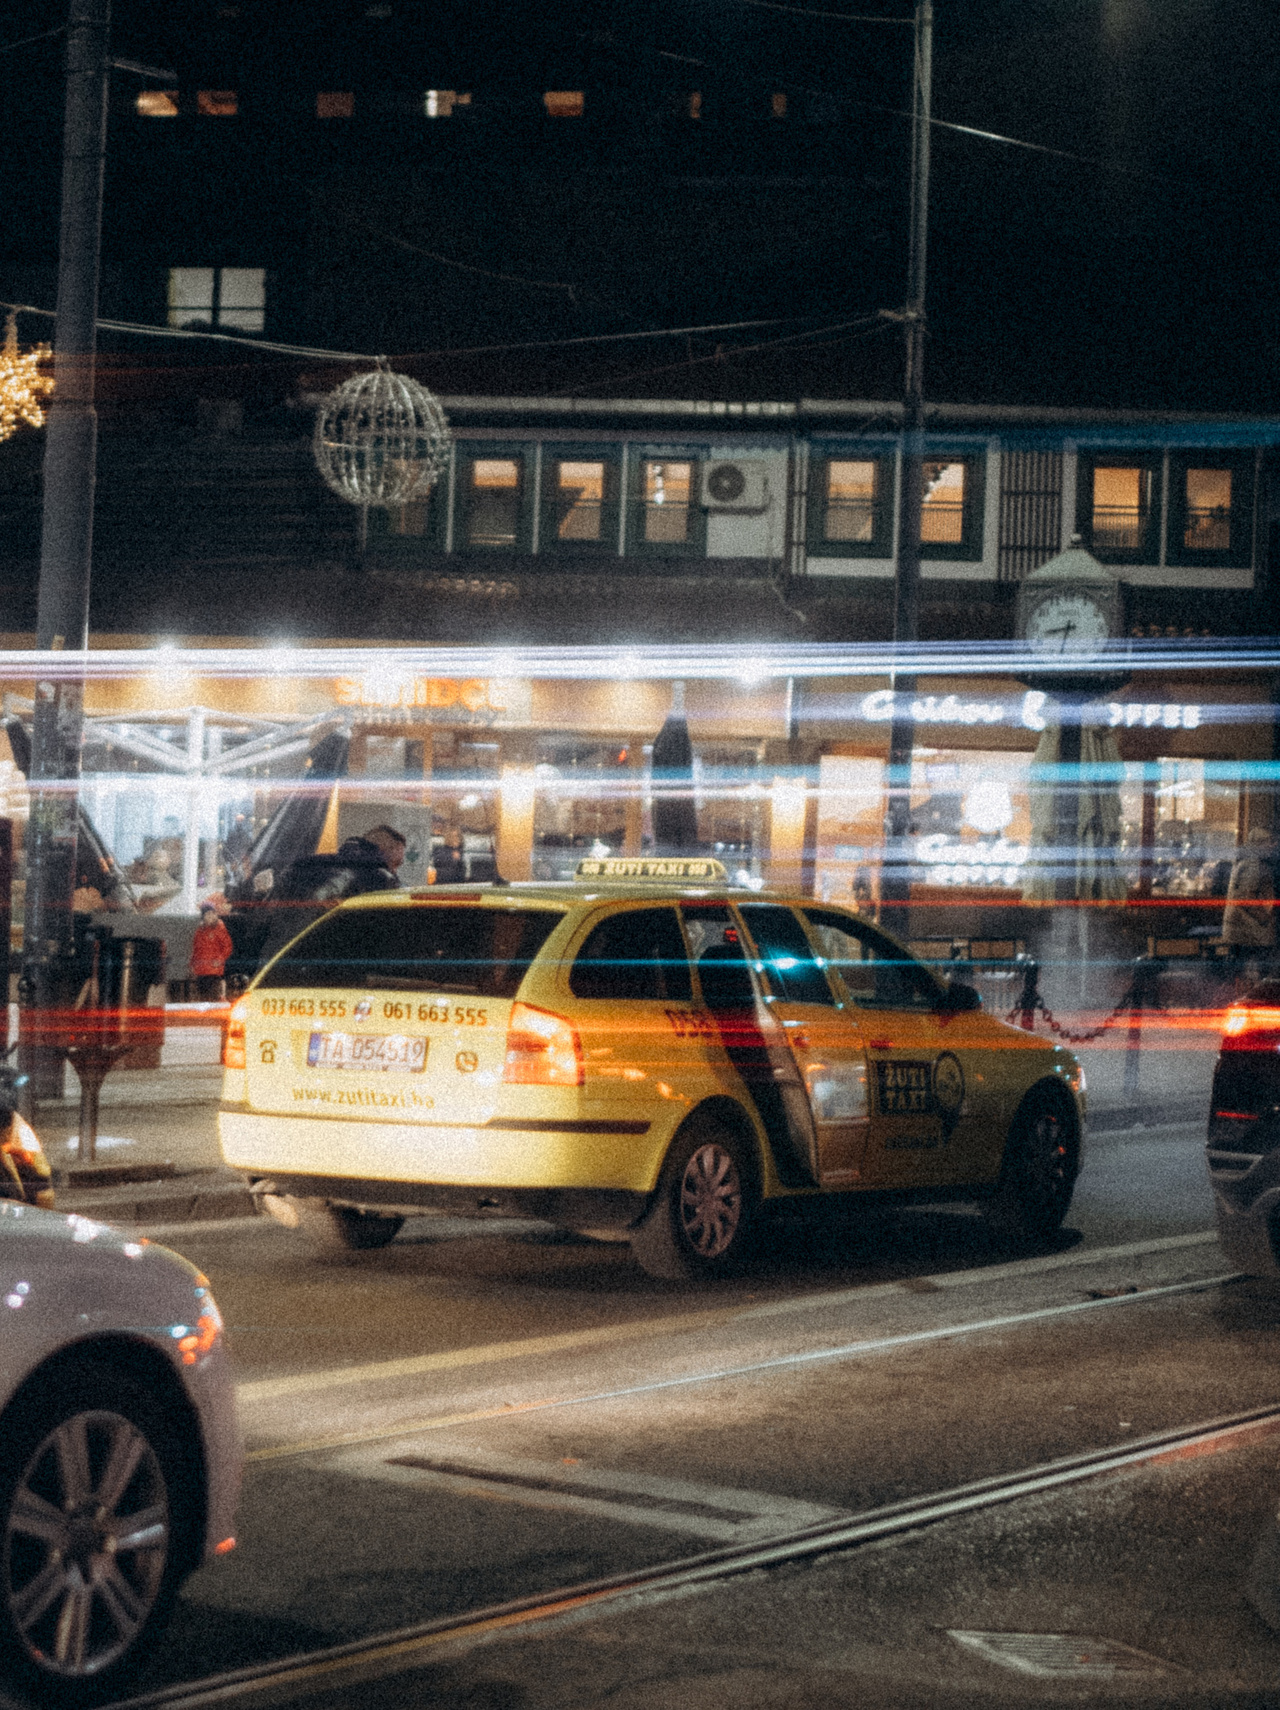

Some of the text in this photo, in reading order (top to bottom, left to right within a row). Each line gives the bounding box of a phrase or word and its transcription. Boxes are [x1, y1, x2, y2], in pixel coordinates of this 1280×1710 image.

[1108, 702, 1201, 729] OFFEE
[646, 862, 684, 875] TAXI
[261, 998, 347, 1018] 033 663 555
[382, 1001, 488, 1027] 061 663 555
[885, 1090, 926, 1110] TAXI
